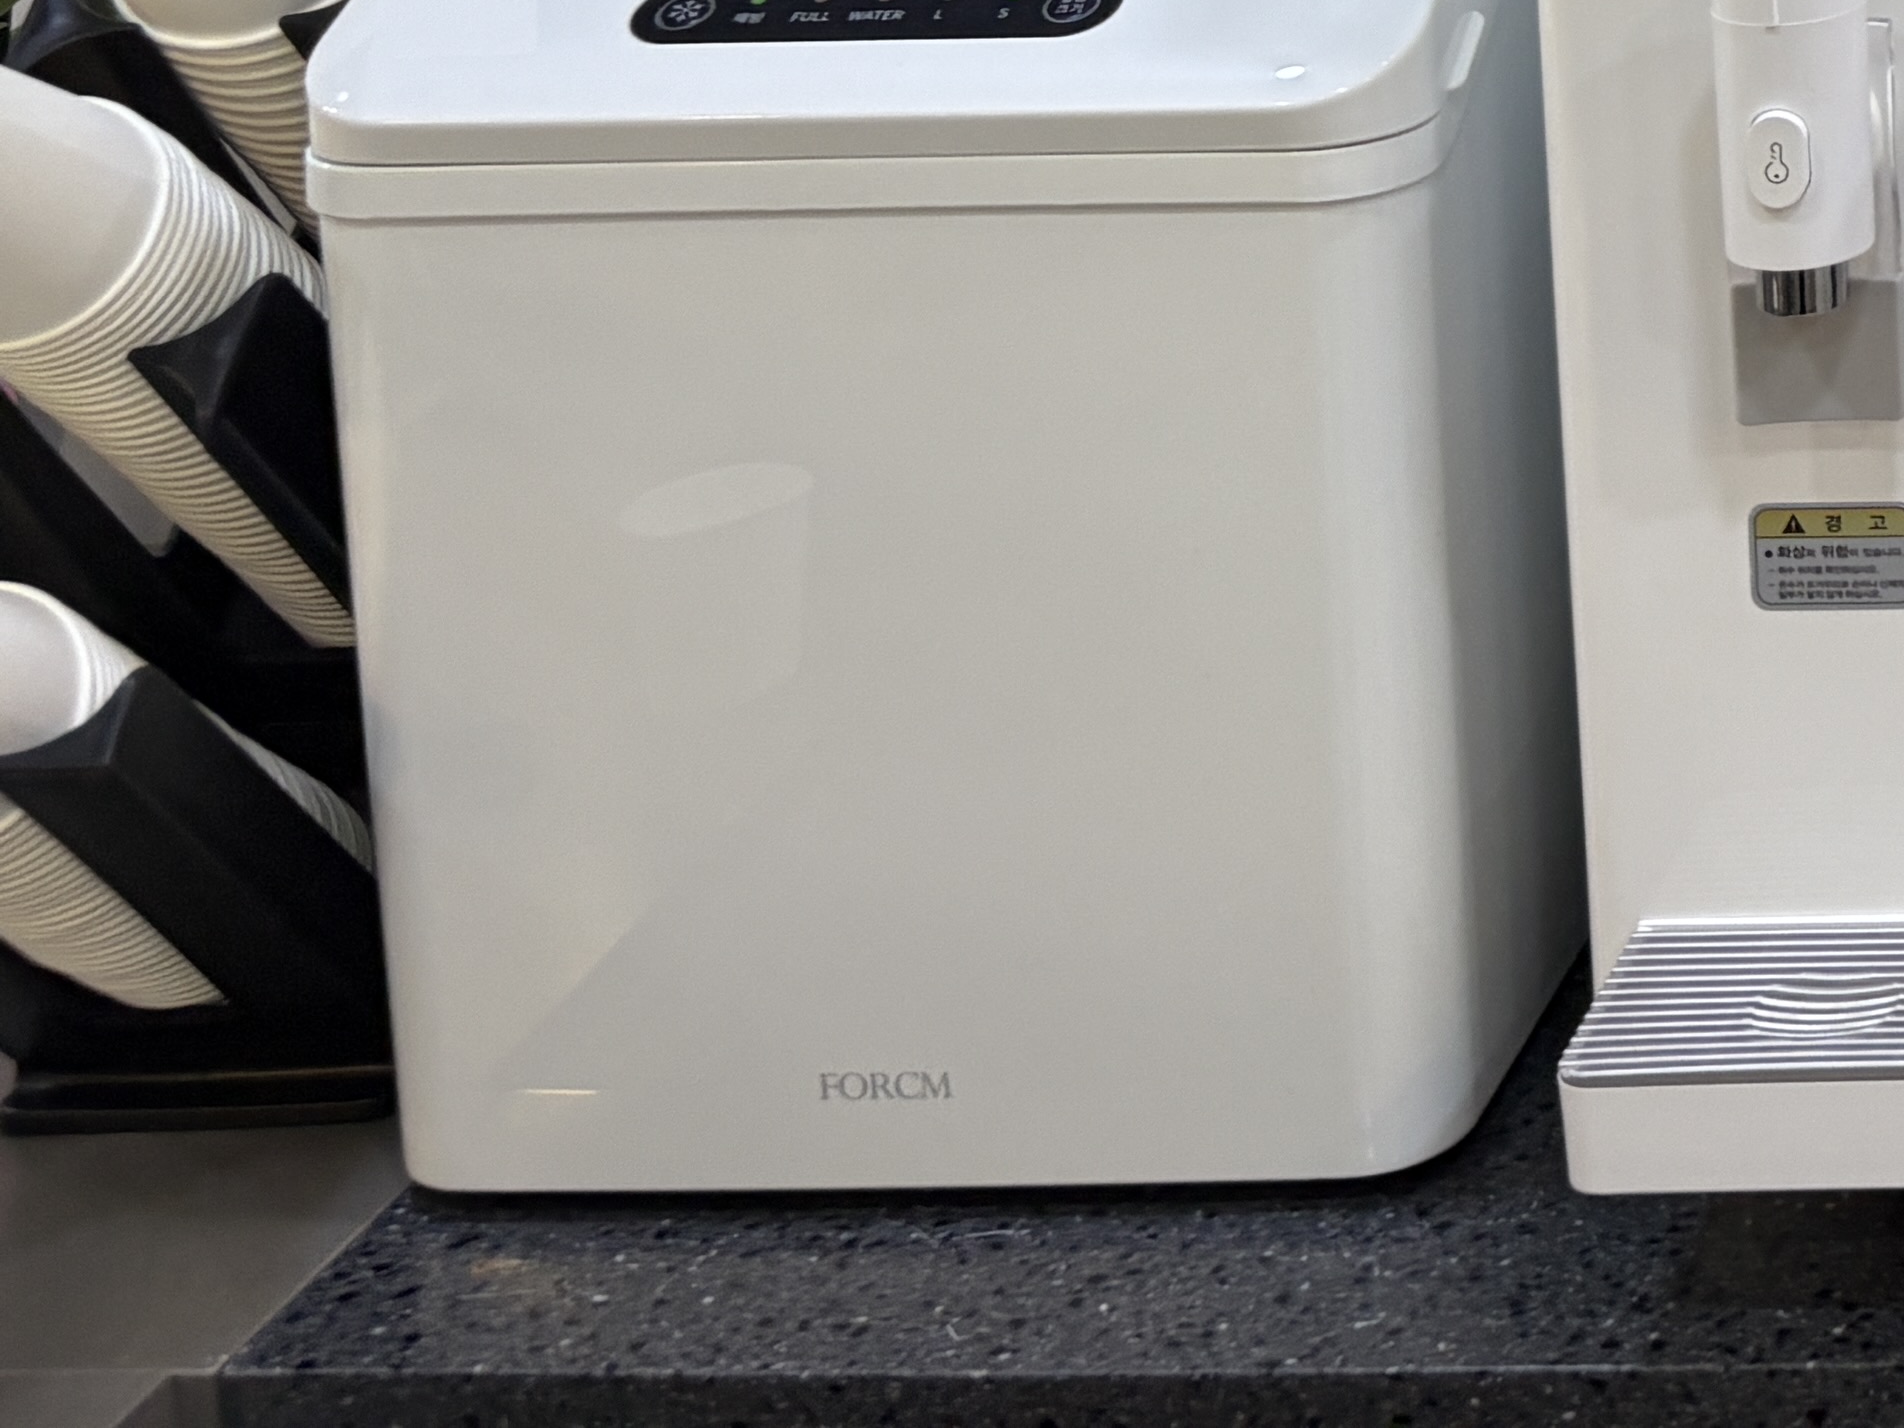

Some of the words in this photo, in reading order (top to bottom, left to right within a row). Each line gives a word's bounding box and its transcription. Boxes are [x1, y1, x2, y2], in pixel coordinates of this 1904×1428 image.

[790, 11, 830, 22] FULL
[848, 9, 905, 21] WATER
[819, 1071, 953, 1101] FORCM
